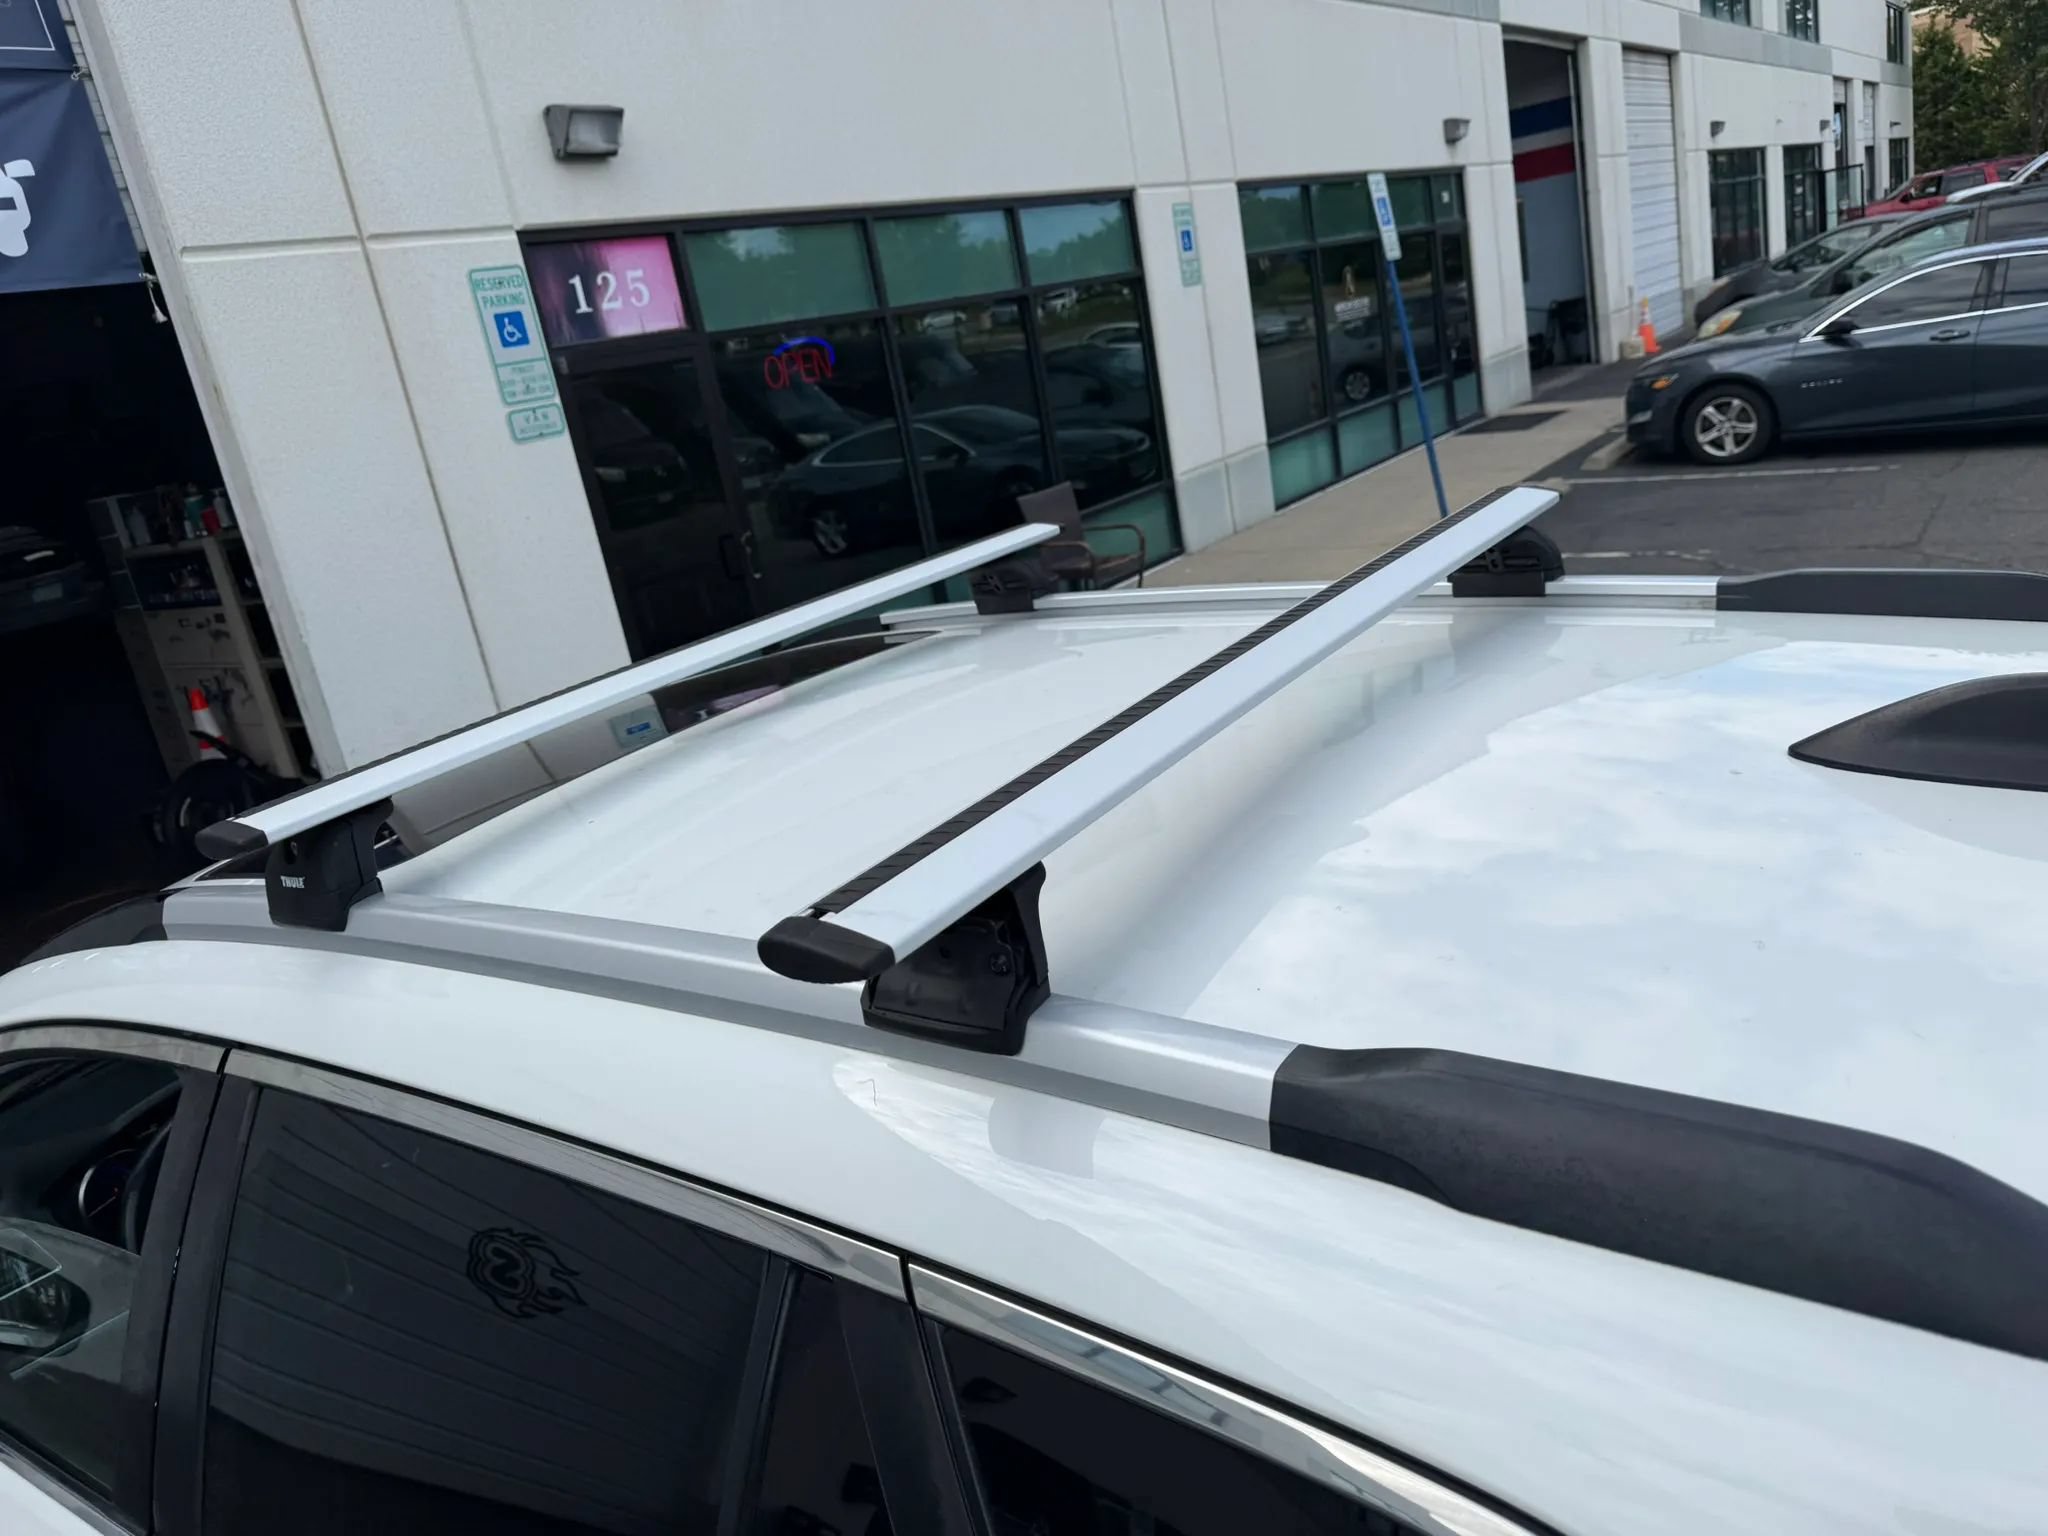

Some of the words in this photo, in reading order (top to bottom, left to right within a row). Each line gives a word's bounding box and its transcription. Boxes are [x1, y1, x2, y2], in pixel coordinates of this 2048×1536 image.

[473, 275, 524, 291] RESERVED
[568, 268, 651, 314] 125
[481, 292, 526, 308] PARKING
[764, 347, 833, 389] OPEN
[280, 875, 305, 889] THULE
